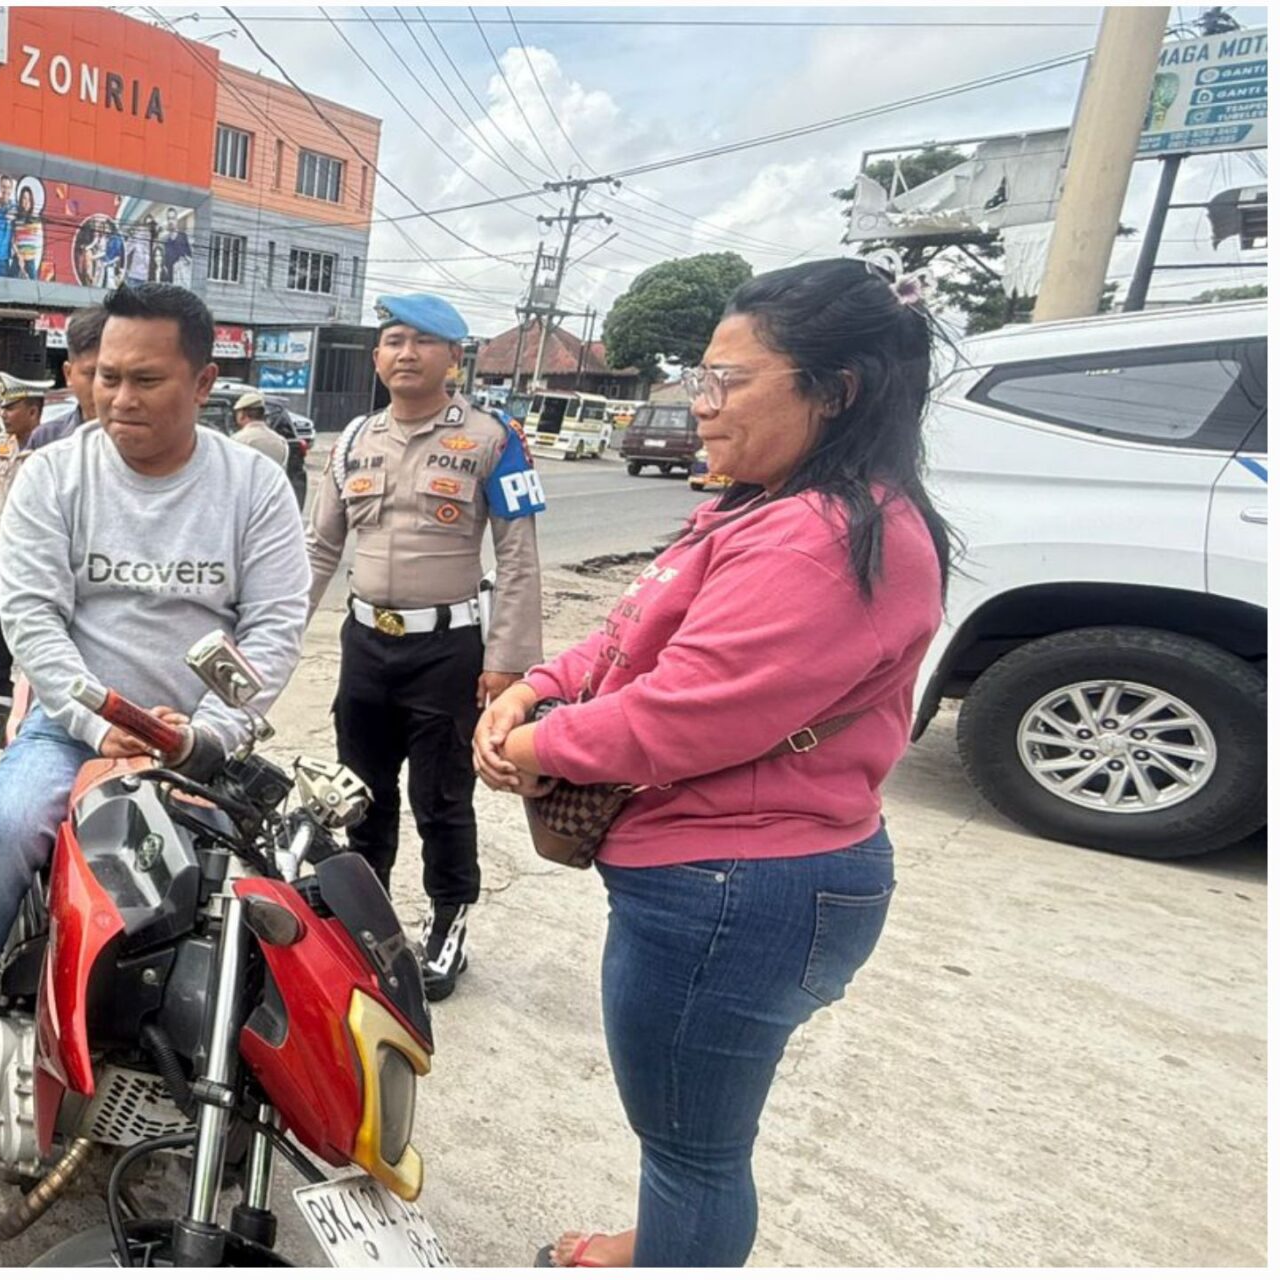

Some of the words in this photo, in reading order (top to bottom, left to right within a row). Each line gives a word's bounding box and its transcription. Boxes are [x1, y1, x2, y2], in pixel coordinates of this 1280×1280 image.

[1218, 33, 1267, 60] MOT
[20, 44, 164, 124] ZONRIA
[426, 454, 478, 472] POLRI
[87, 552, 226, 585] Dcovers
[306, 1194, 354, 1245] BK
